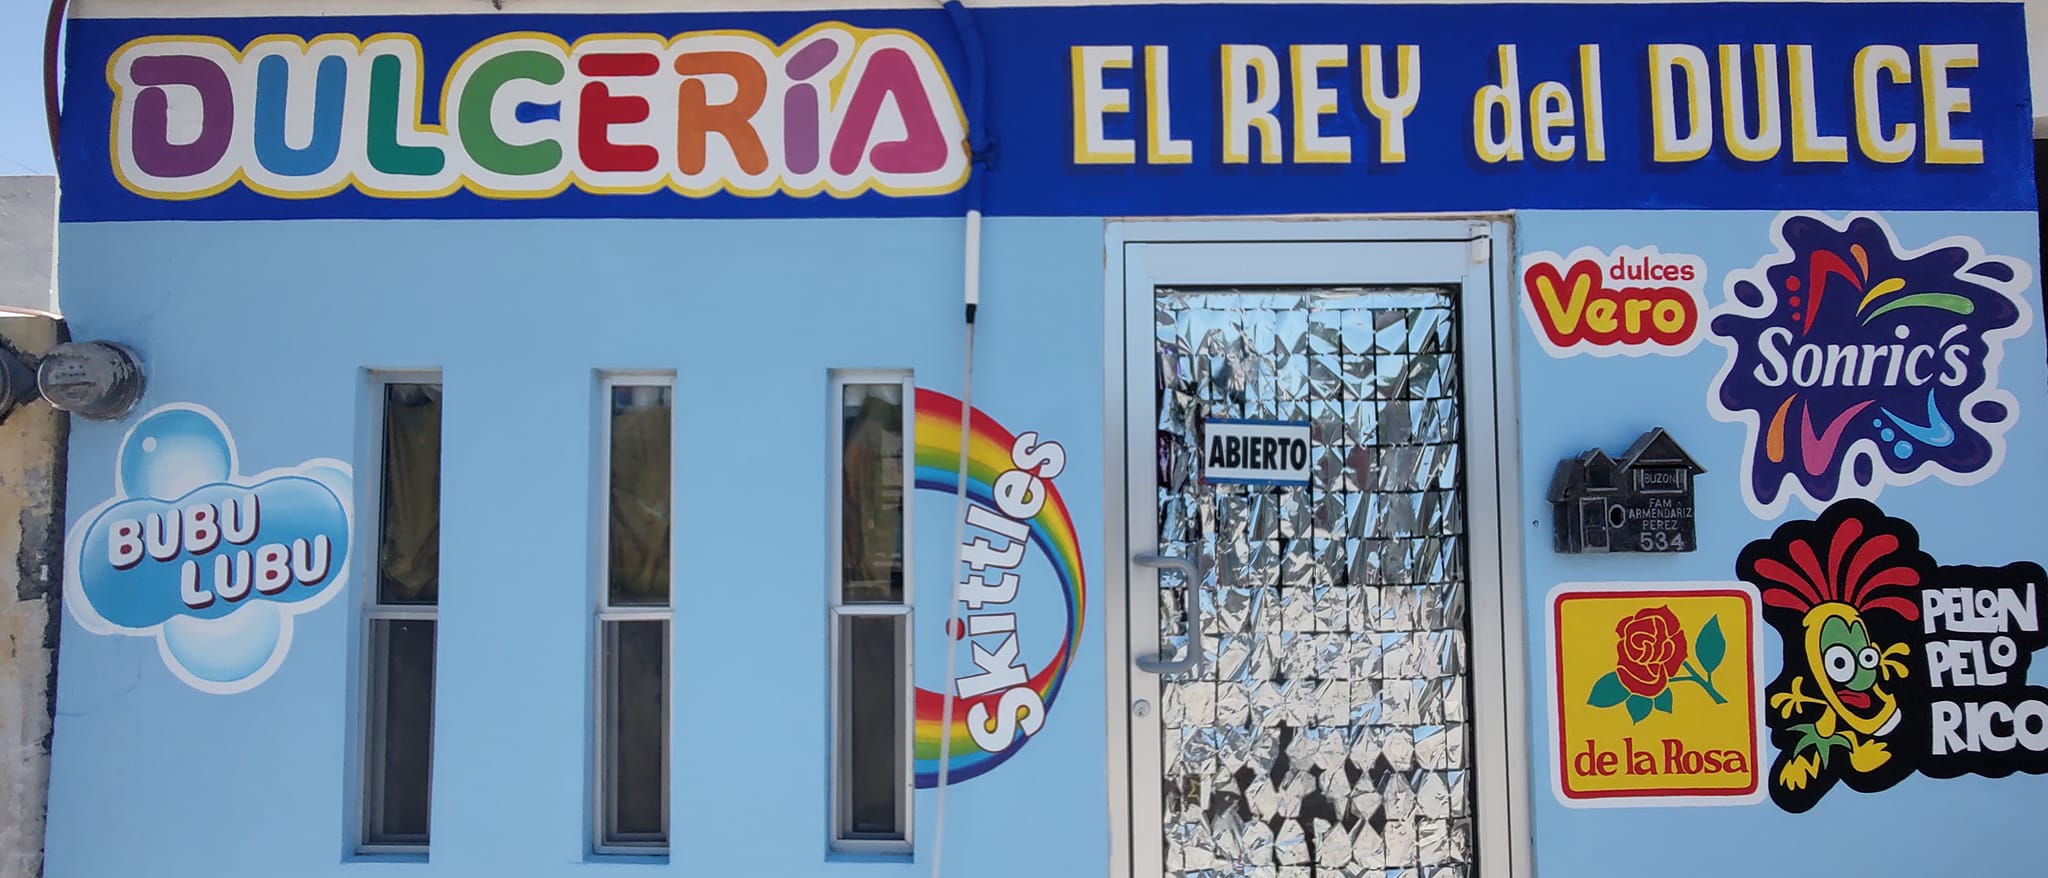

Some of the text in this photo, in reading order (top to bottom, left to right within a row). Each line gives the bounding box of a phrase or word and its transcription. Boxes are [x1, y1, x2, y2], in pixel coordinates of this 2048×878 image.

[130, 37, 948, 177] DULCERÍA
[1070, 44, 1984, 165] EL REY del DULCE
[1610, 256, 1695, 282] dulces
[1536, 273, 1686, 335] Vero
[1753, 324, 1970, 388] Sonric's
[1208, 435, 1307, 471] ABIERTO
[1644, 473, 1676, 484] BUZON
[1642, 520, 1678, 530] PEREZ
[1649, 498, 1672, 508] FAM
[108, 493, 260, 571] BUBU
[1640, 531, 1684, 551] 534
[181, 534, 331, 609] LUBU
[1921, 583, 2039, 634] PELON
[1925, 635, 2017, 688] PELO
[1931, 699, 2048, 755] RICO
[1574, 737, 1749, 776] de la Rosa
